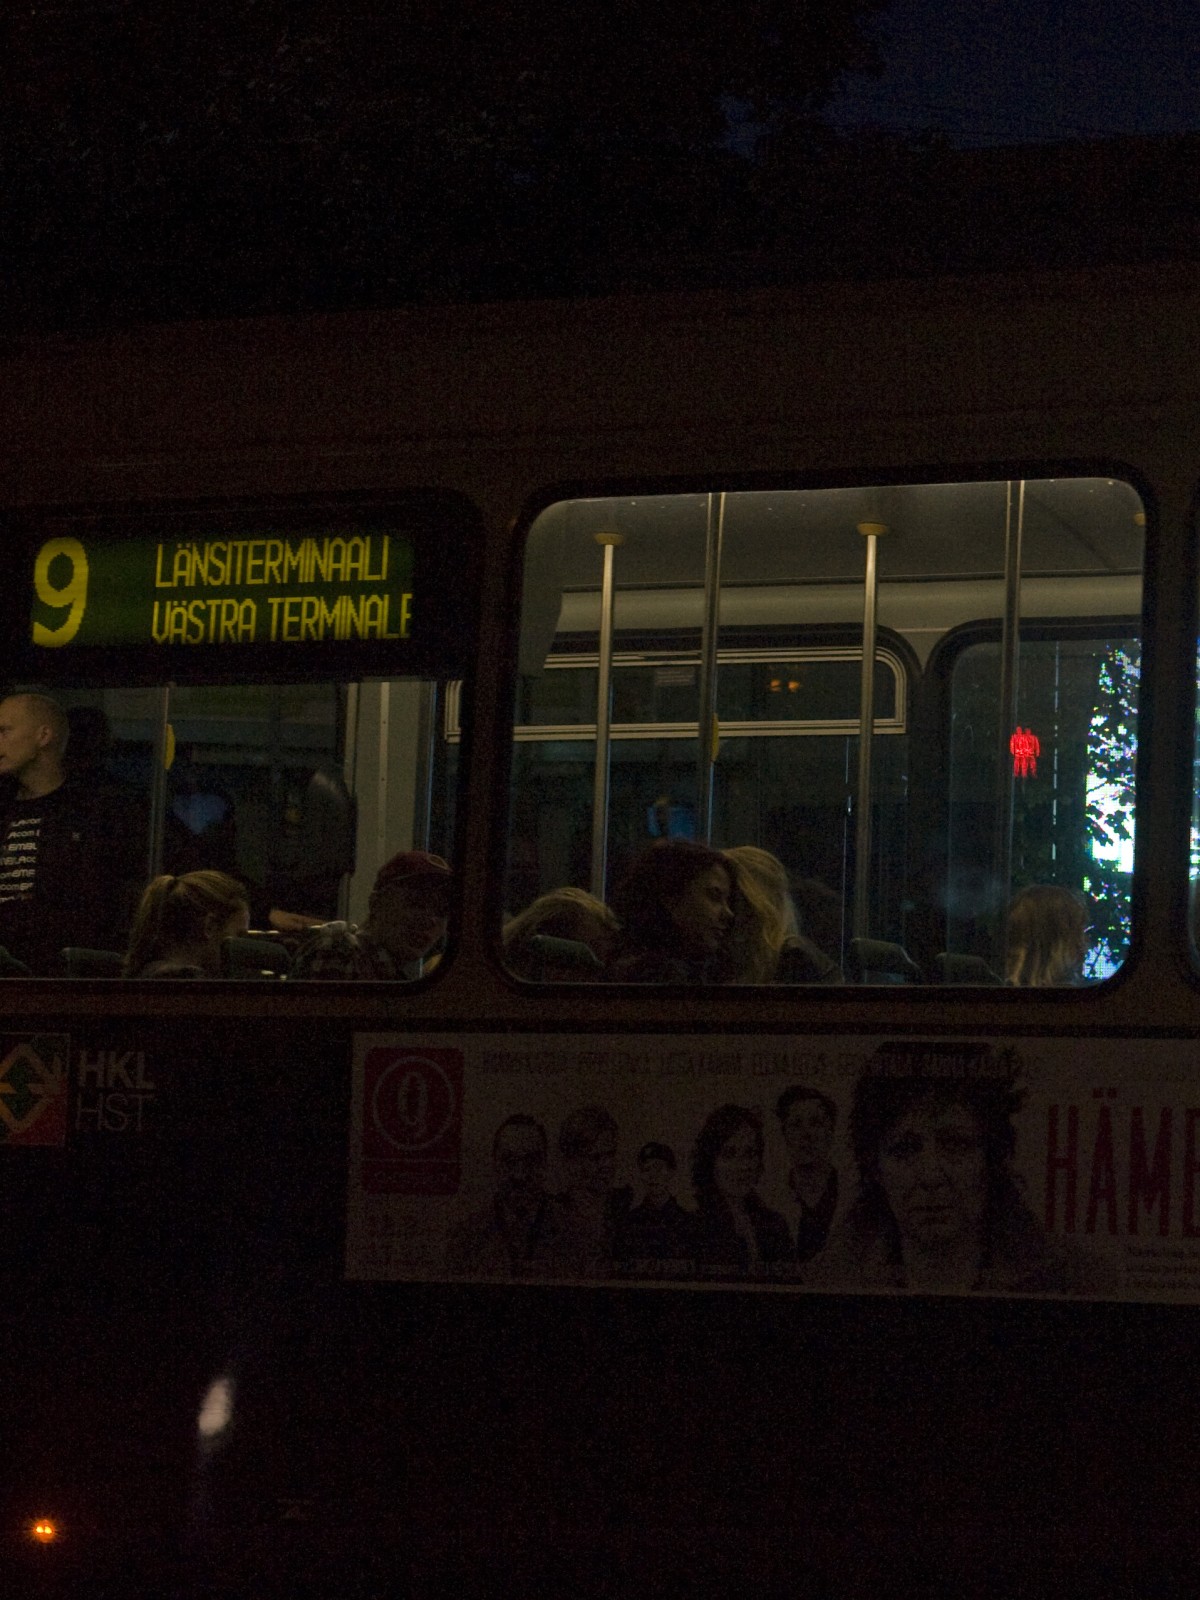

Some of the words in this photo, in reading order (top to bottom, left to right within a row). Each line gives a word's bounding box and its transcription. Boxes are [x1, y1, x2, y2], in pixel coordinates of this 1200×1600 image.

[154, 535, 391, 588] LÄNSITERMINAALI
[32, 536, 89, 648] 9
[78, 1050, 156, 1090] HKL
[75, 1092, 157, 1133] HST
